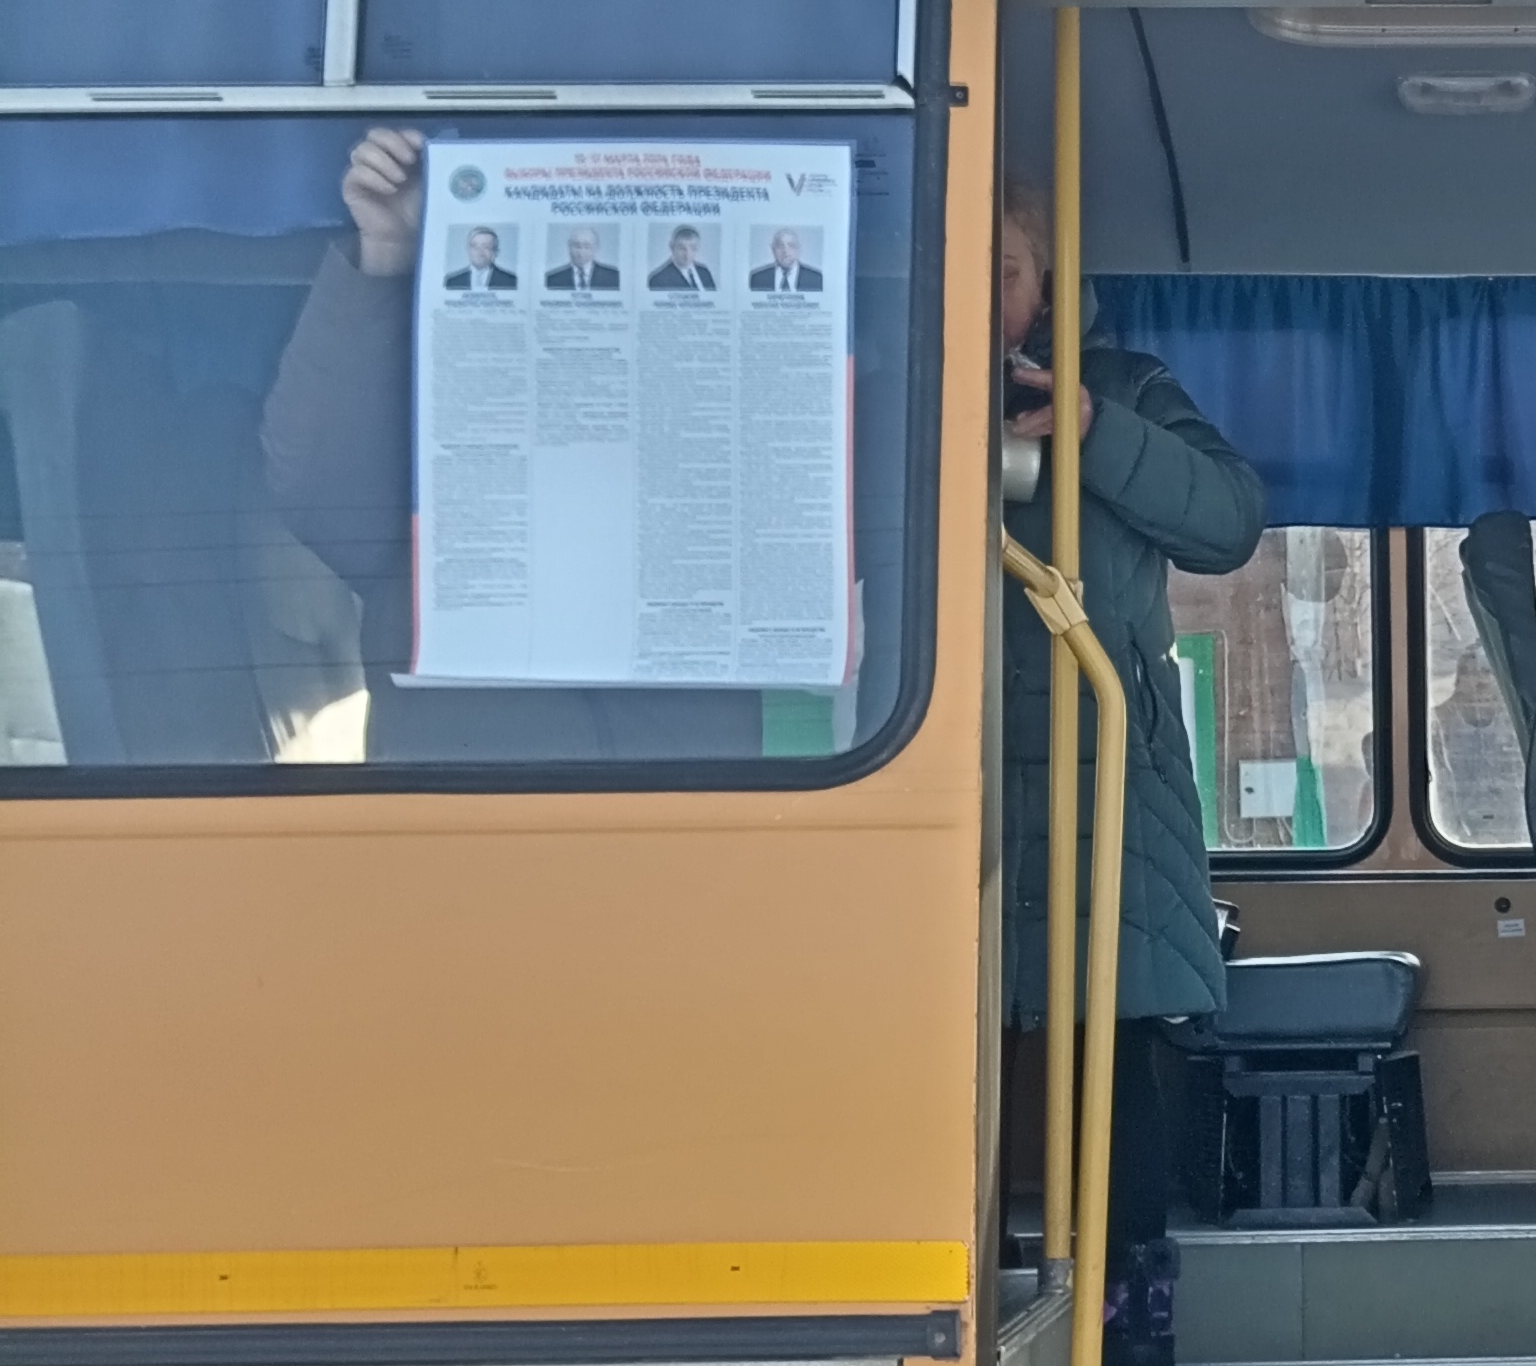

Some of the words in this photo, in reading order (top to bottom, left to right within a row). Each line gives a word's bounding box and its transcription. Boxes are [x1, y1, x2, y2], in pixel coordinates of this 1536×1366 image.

[504, 184, 583, 200] КАНДИДАТЫ
[585, 185, 603, 198] НА
[605, 184, 685, 200] ДОЛЖНОСТЬ
[687, 184, 770, 203] ПРЕЗИДЕНТА
[551, 200, 637, 216] РОССИЙСКОЙ
[639, 200, 720, 217] ФЕДЕРАЦИИ
